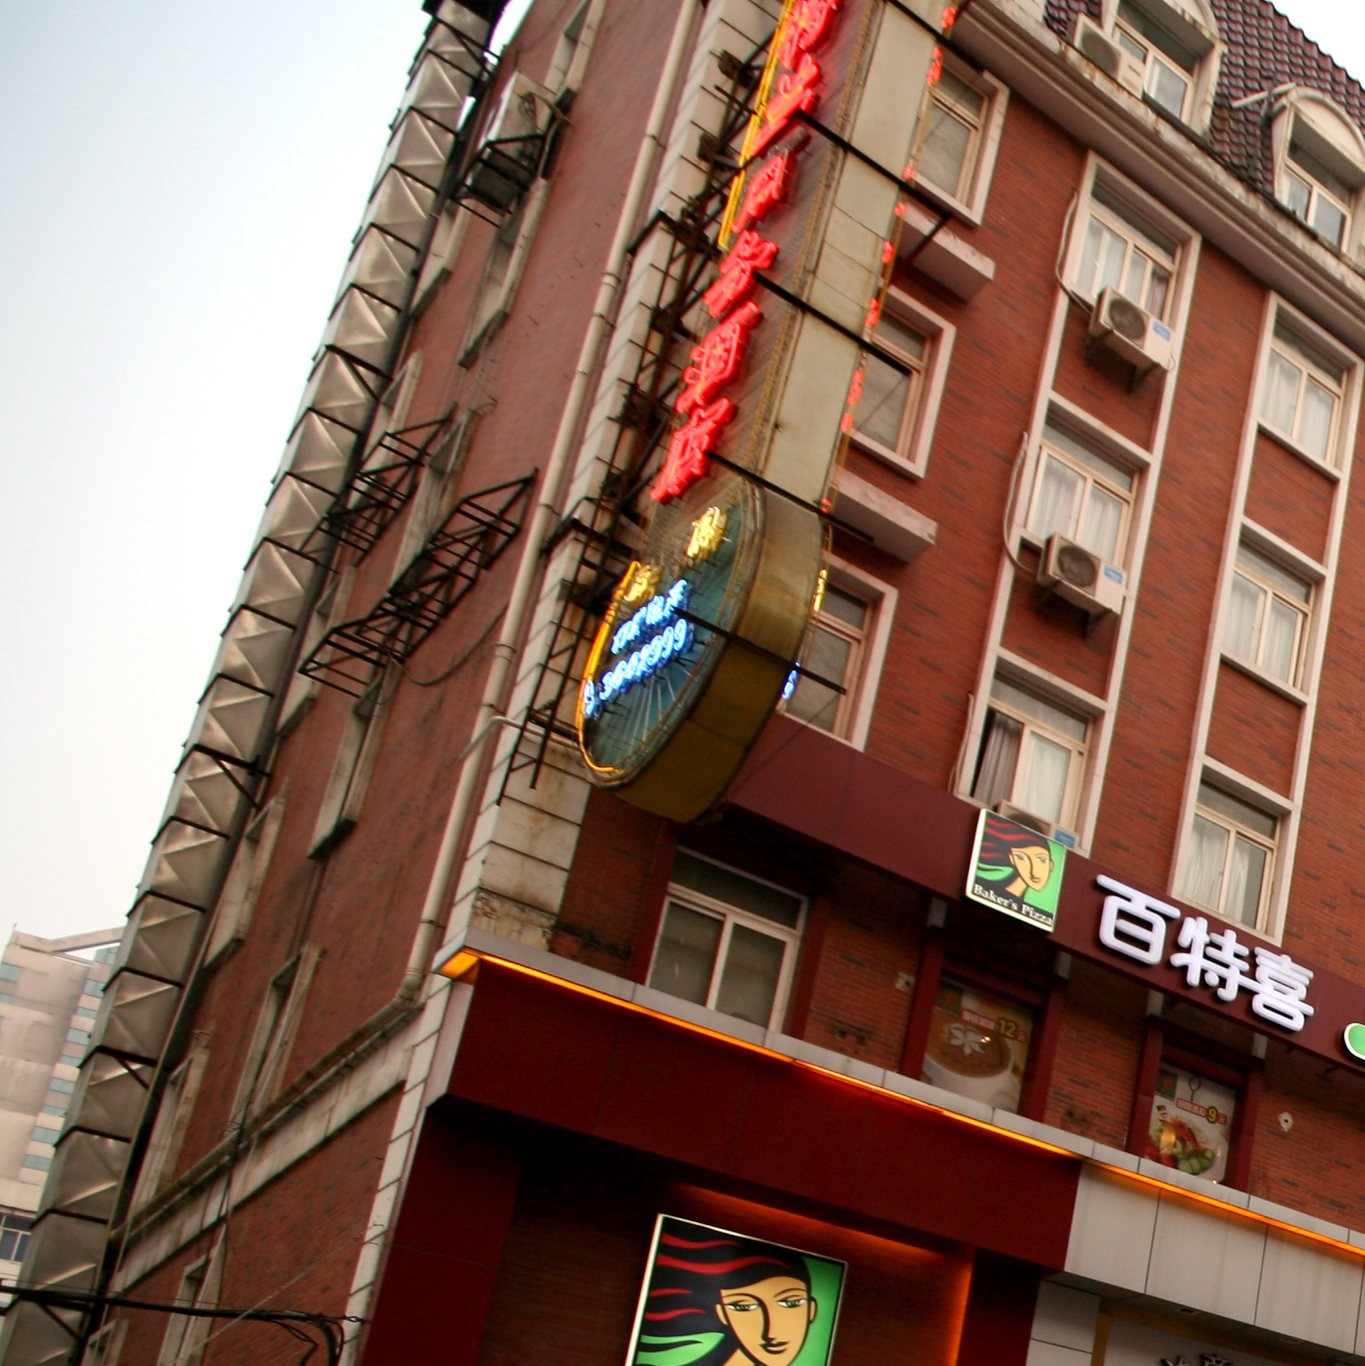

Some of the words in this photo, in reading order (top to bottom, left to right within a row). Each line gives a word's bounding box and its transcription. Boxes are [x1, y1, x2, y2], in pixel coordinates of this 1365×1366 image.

[973, 882, 1019, 916] Baker's
[1021, 904, 1053, 928] Pizza
[1097, 874, 1314, 1031] 百特喜
